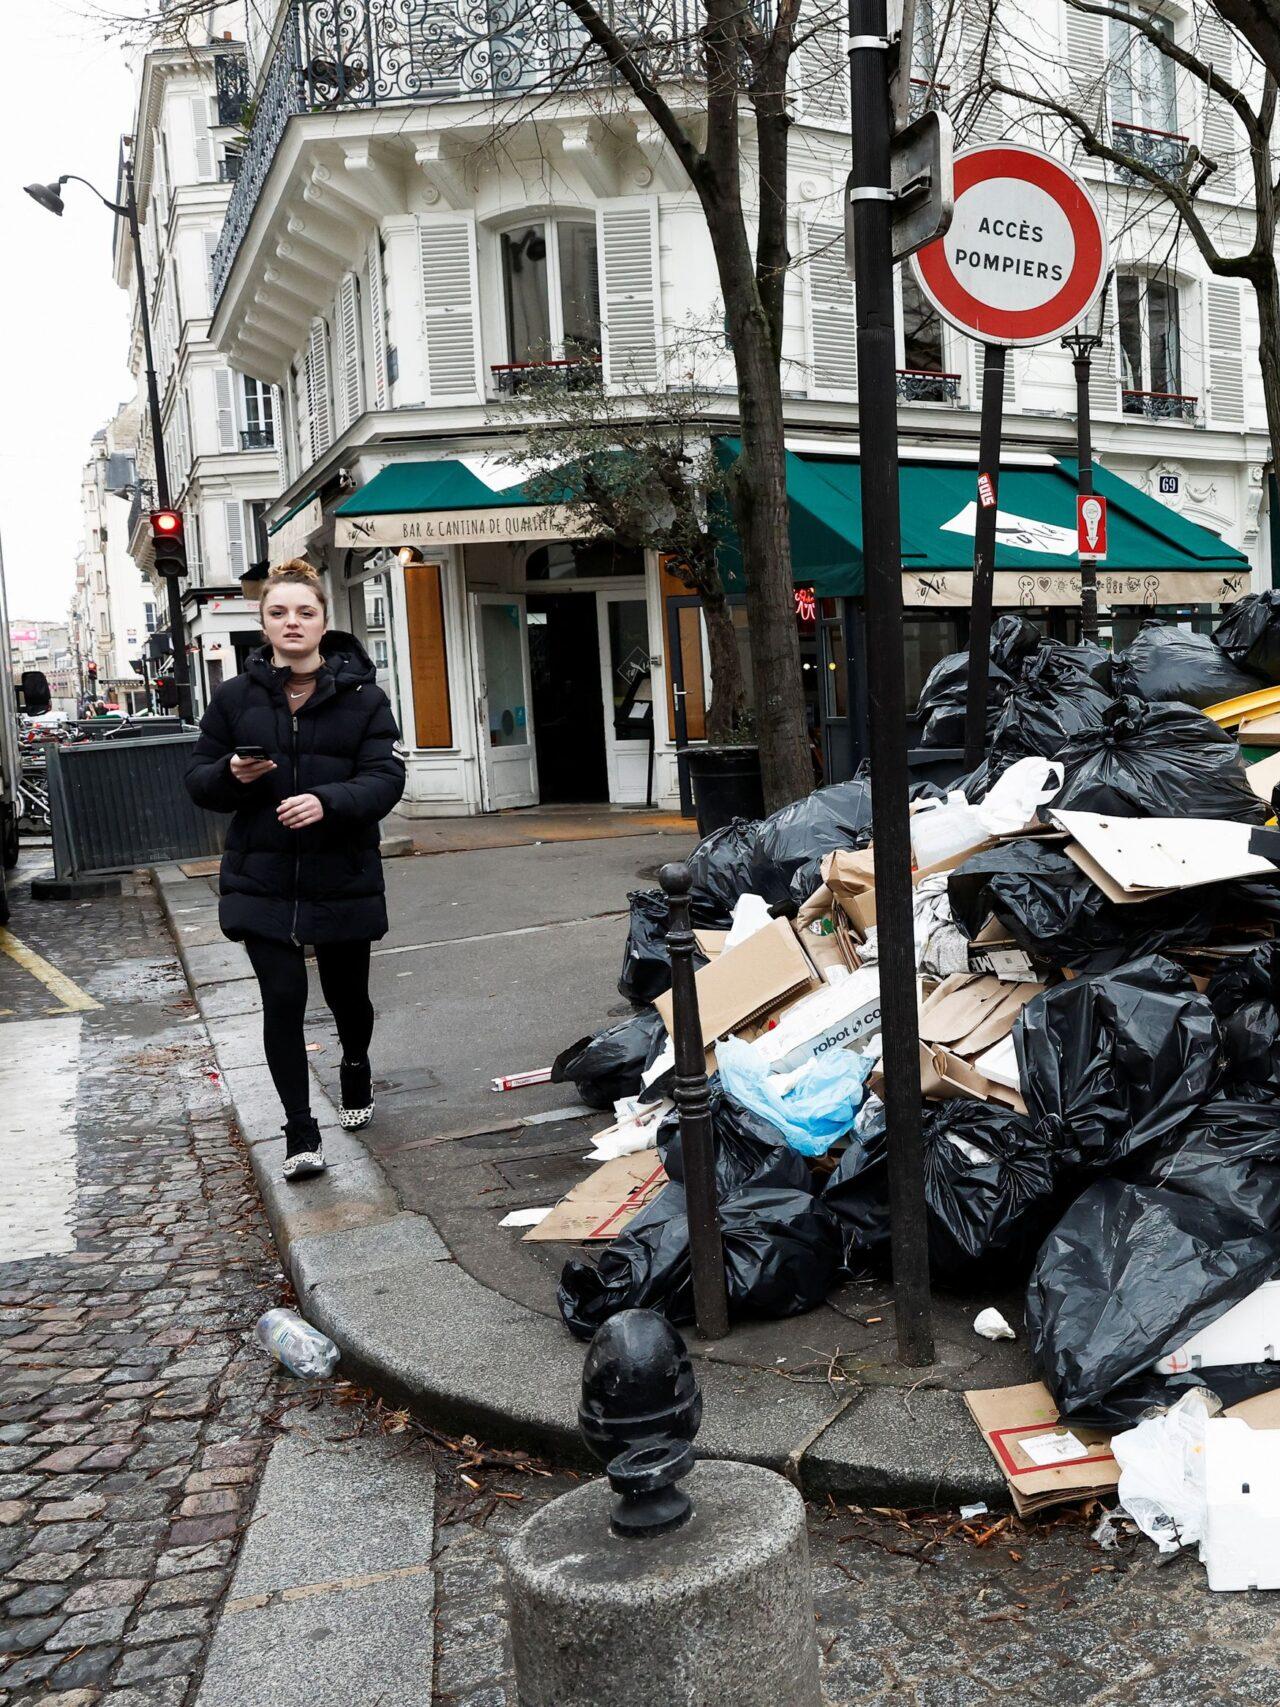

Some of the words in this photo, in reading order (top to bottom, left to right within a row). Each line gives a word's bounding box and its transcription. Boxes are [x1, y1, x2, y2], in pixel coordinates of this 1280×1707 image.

[979, 217, 1043, 243] ACCÈS
[955, 248, 1063, 281] POMPIERS
[1162, 477, 1176, 492] 69
[402, 522, 422, 538] BAR
[426, 522, 434, 537] &
[438, 519, 486, 536] CANTINA
[489, 518, 501, 535] DE
[813, 1027, 850, 1056] robot
[864, 1008, 881, 1024] co
